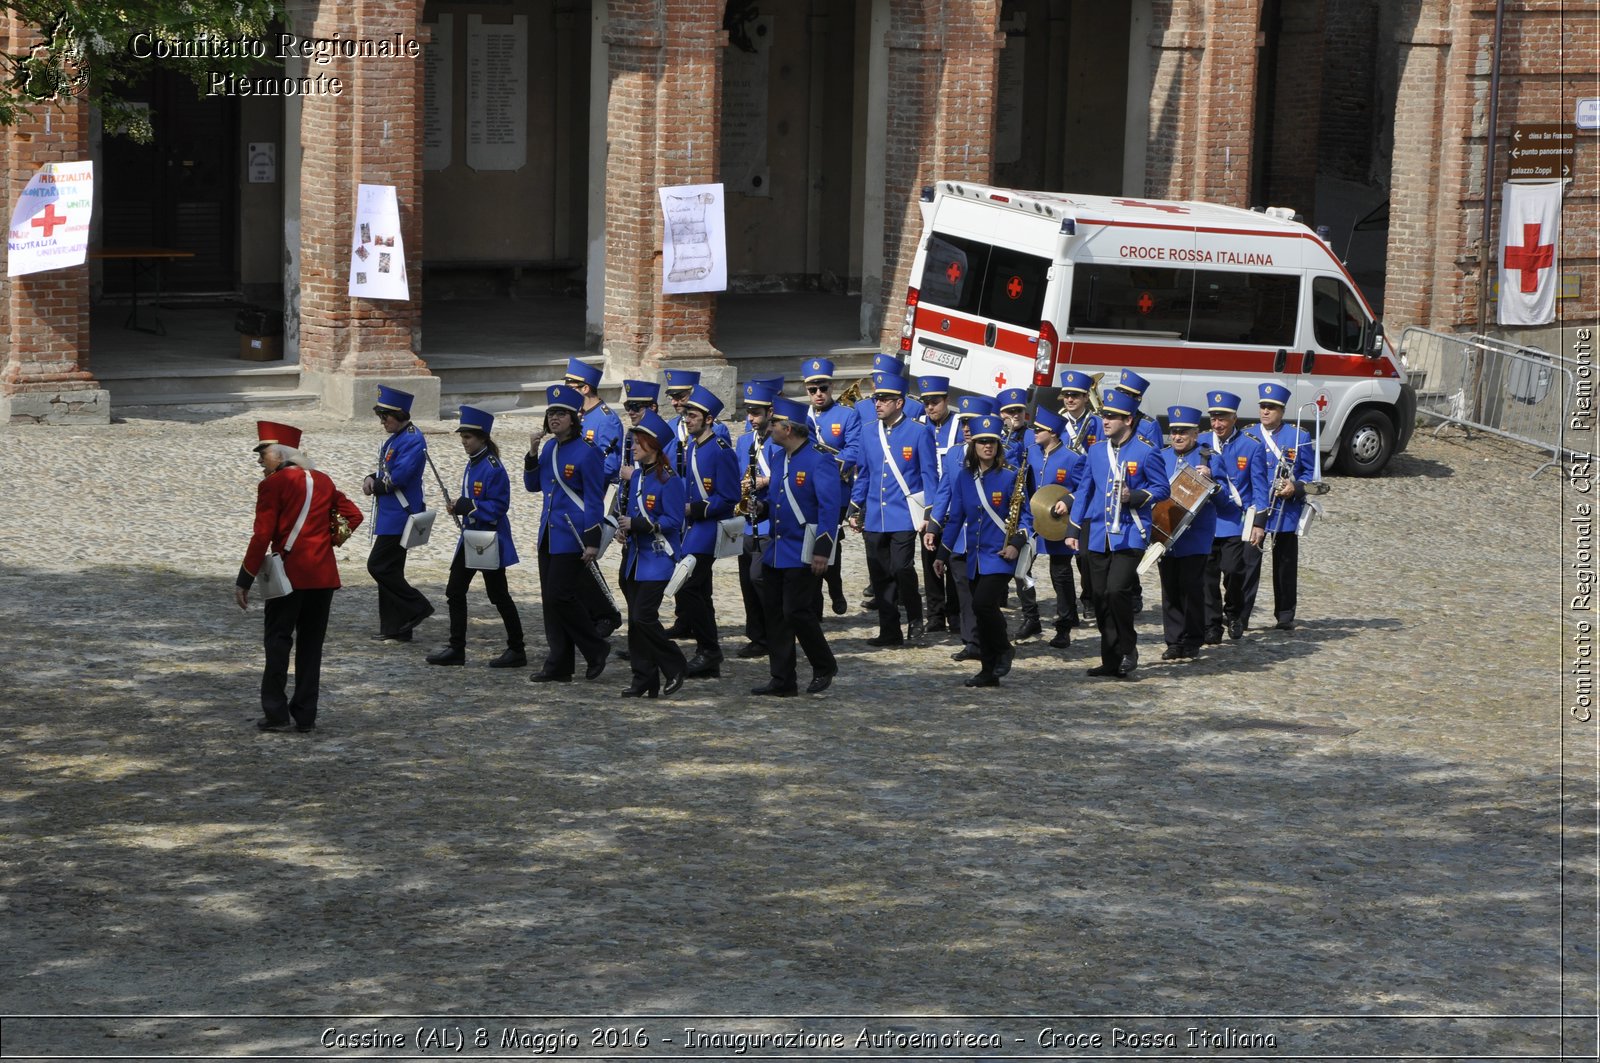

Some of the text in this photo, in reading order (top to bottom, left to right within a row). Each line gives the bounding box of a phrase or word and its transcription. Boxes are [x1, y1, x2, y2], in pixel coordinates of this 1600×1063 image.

[1521, 147, 1573, 156] punto panoramico
[1511, 166, 1552, 175] palazzo Zoppi
[1119, 245, 1274, 266] CROCE ROSSA ITALIANA
